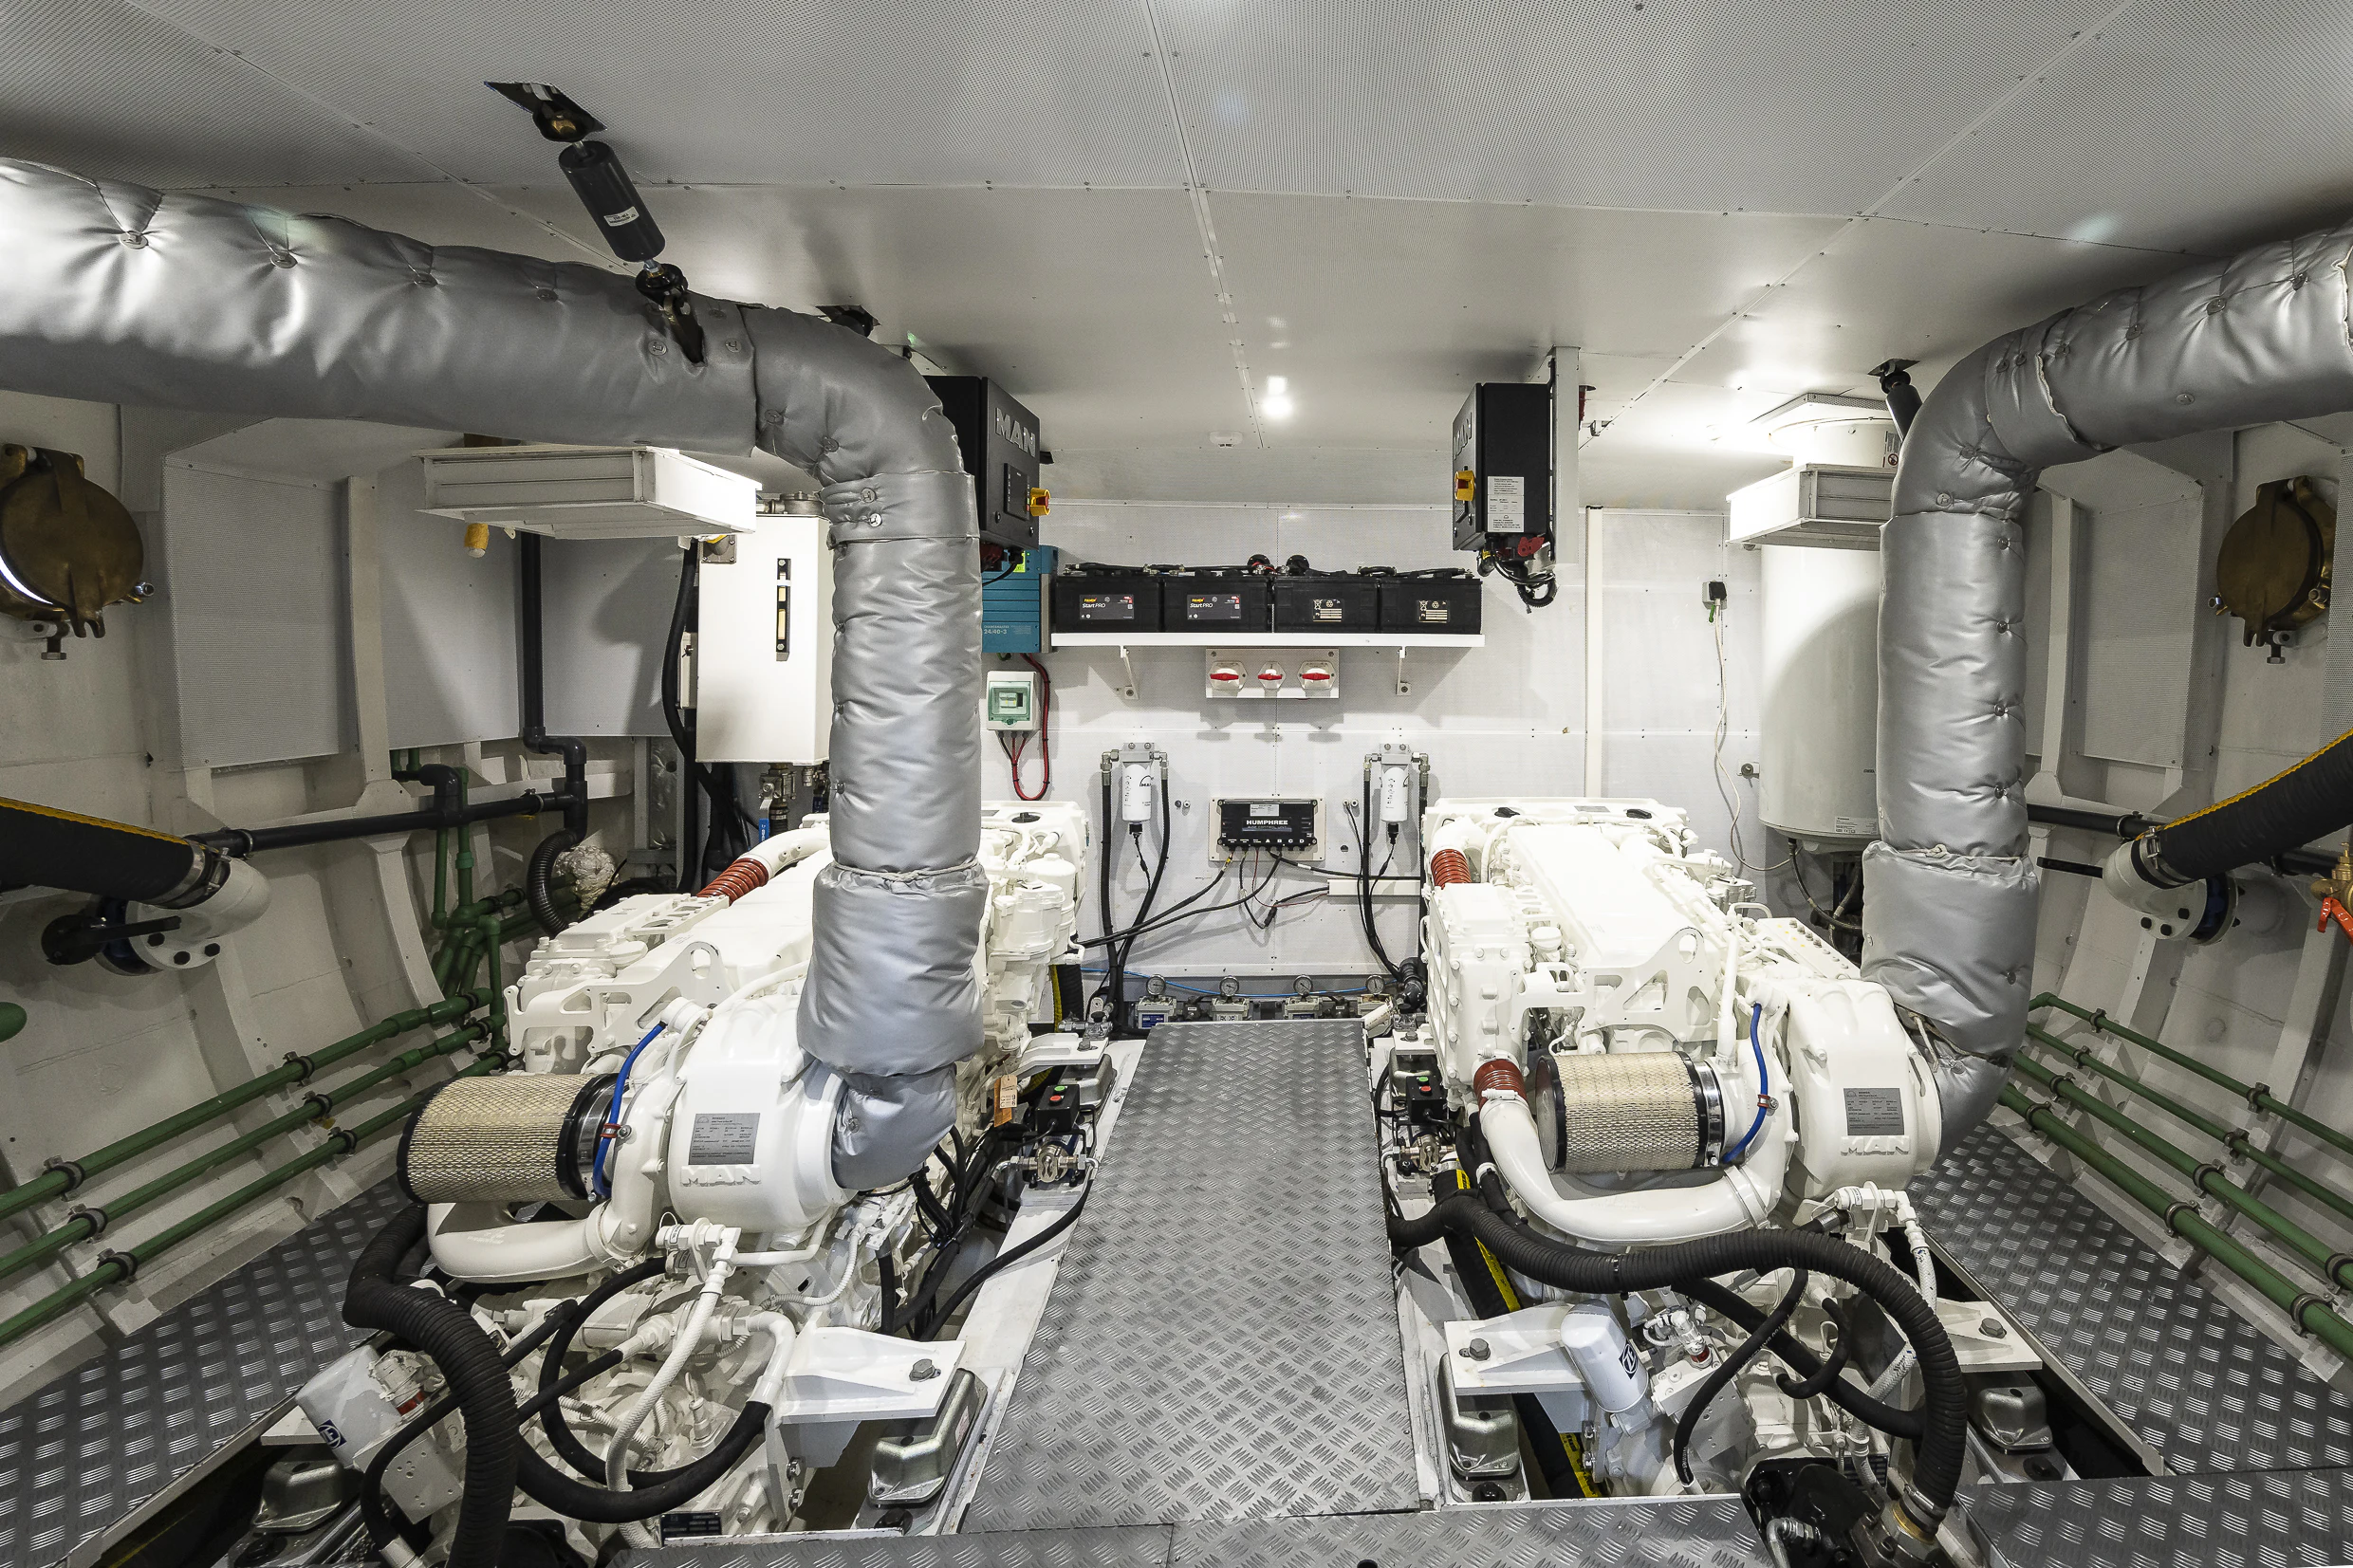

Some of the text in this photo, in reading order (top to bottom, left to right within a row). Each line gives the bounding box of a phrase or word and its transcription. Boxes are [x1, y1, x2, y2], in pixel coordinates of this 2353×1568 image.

[995, 407, 1036, 458] MAN
[1454, 412, 1473, 461] MAN
[1840, 1135, 1909, 1156] MAN
[680, 1165, 761, 1187] MAN
